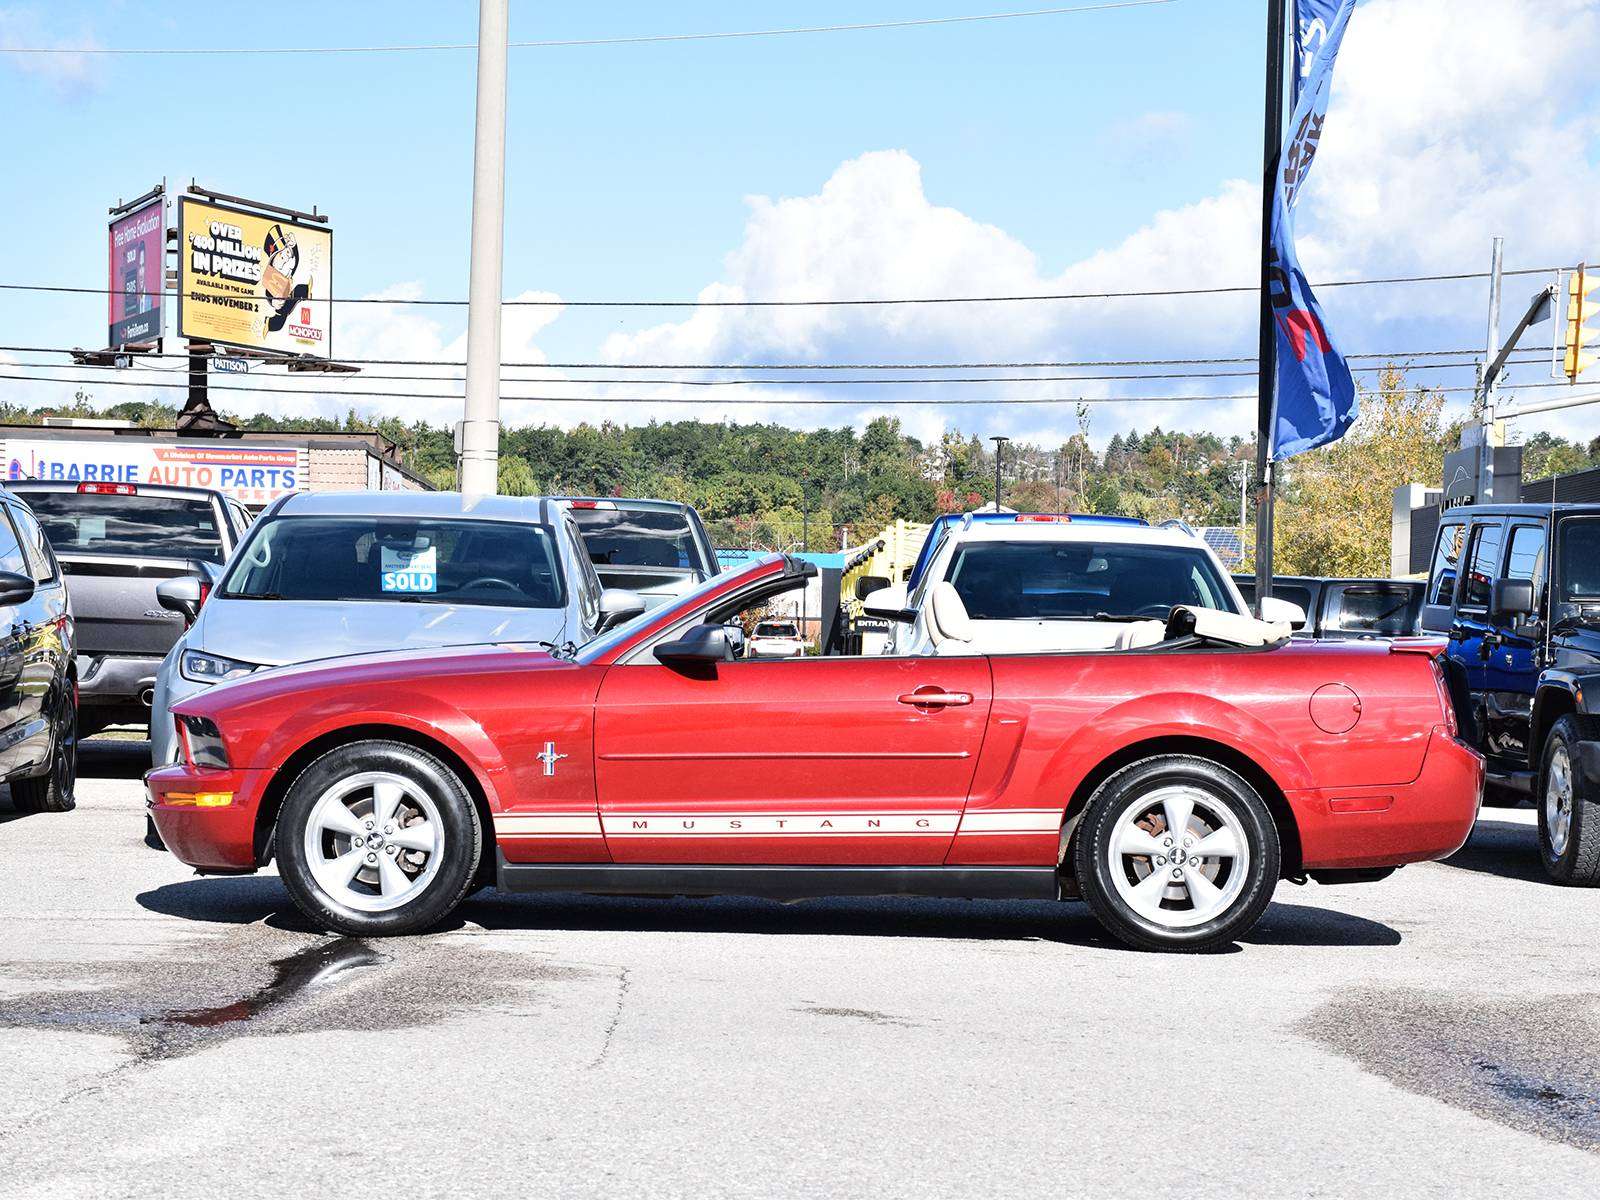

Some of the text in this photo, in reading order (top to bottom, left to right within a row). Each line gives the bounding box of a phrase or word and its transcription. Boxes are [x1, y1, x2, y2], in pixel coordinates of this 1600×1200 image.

[115, 230, 124, 248] Free
[124, 225, 136, 243] Home
[210, 220, 242, 240] OVER
[216, 238, 262, 261] MILLION
[192, 252, 261, 282] IN PRIZES
[196, 279, 223, 290] AVAILABLE
[231, 285, 240, 293] THE
[241, 287, 254, 296] GAME
[191, 291, 259, 312] ENDS NOVEMBER 2
[289, 326, 322, 340] MONOPOLY
[214, 358, 248, 373] PATTISON
[169, 451, 195, 460] Division
[276, 455, 296, 464] Group
[50, 462, 296, 489] BARRIE AUTO PARTS
[384, 572, 433, 591] SOLD
[632, 818, 931, 830] MUSTANG
